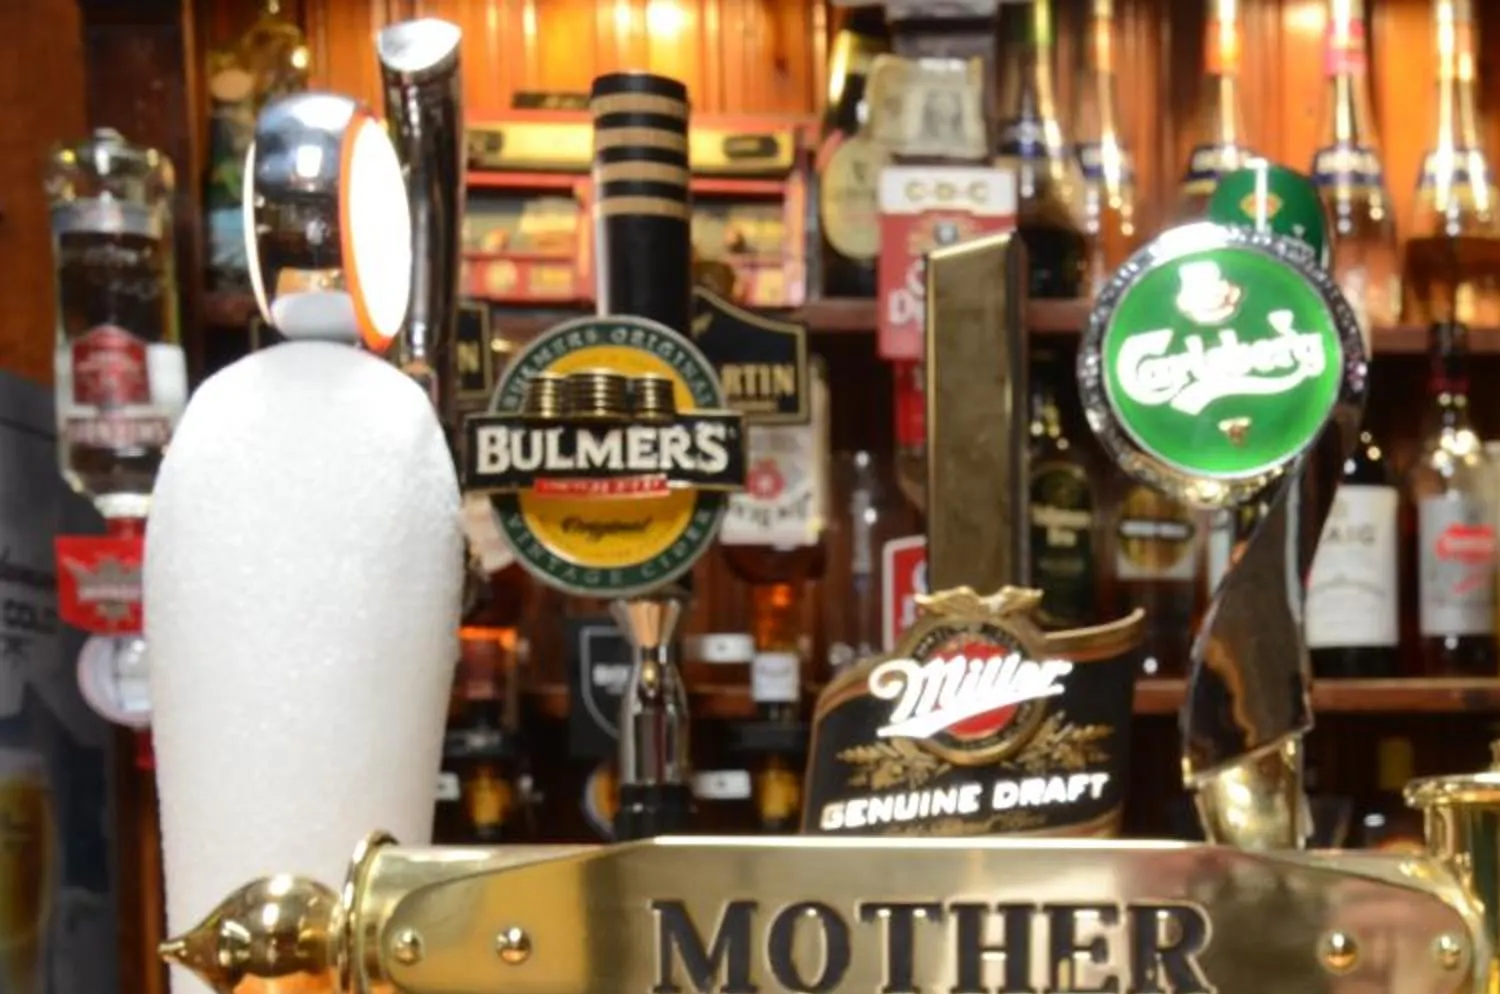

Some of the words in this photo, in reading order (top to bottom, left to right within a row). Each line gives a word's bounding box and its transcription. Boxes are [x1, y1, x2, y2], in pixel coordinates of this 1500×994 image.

[720, 362, 797, 397] RTIN
[1116, 308, 1327, 416] Carlsberg
[475, 420, 729, 475] BULMERS
[868, 651, 1073, 739] Miller
[820, 784, 983, 831] GENUINE
[992, 772, 1111, 810] DRAFT
